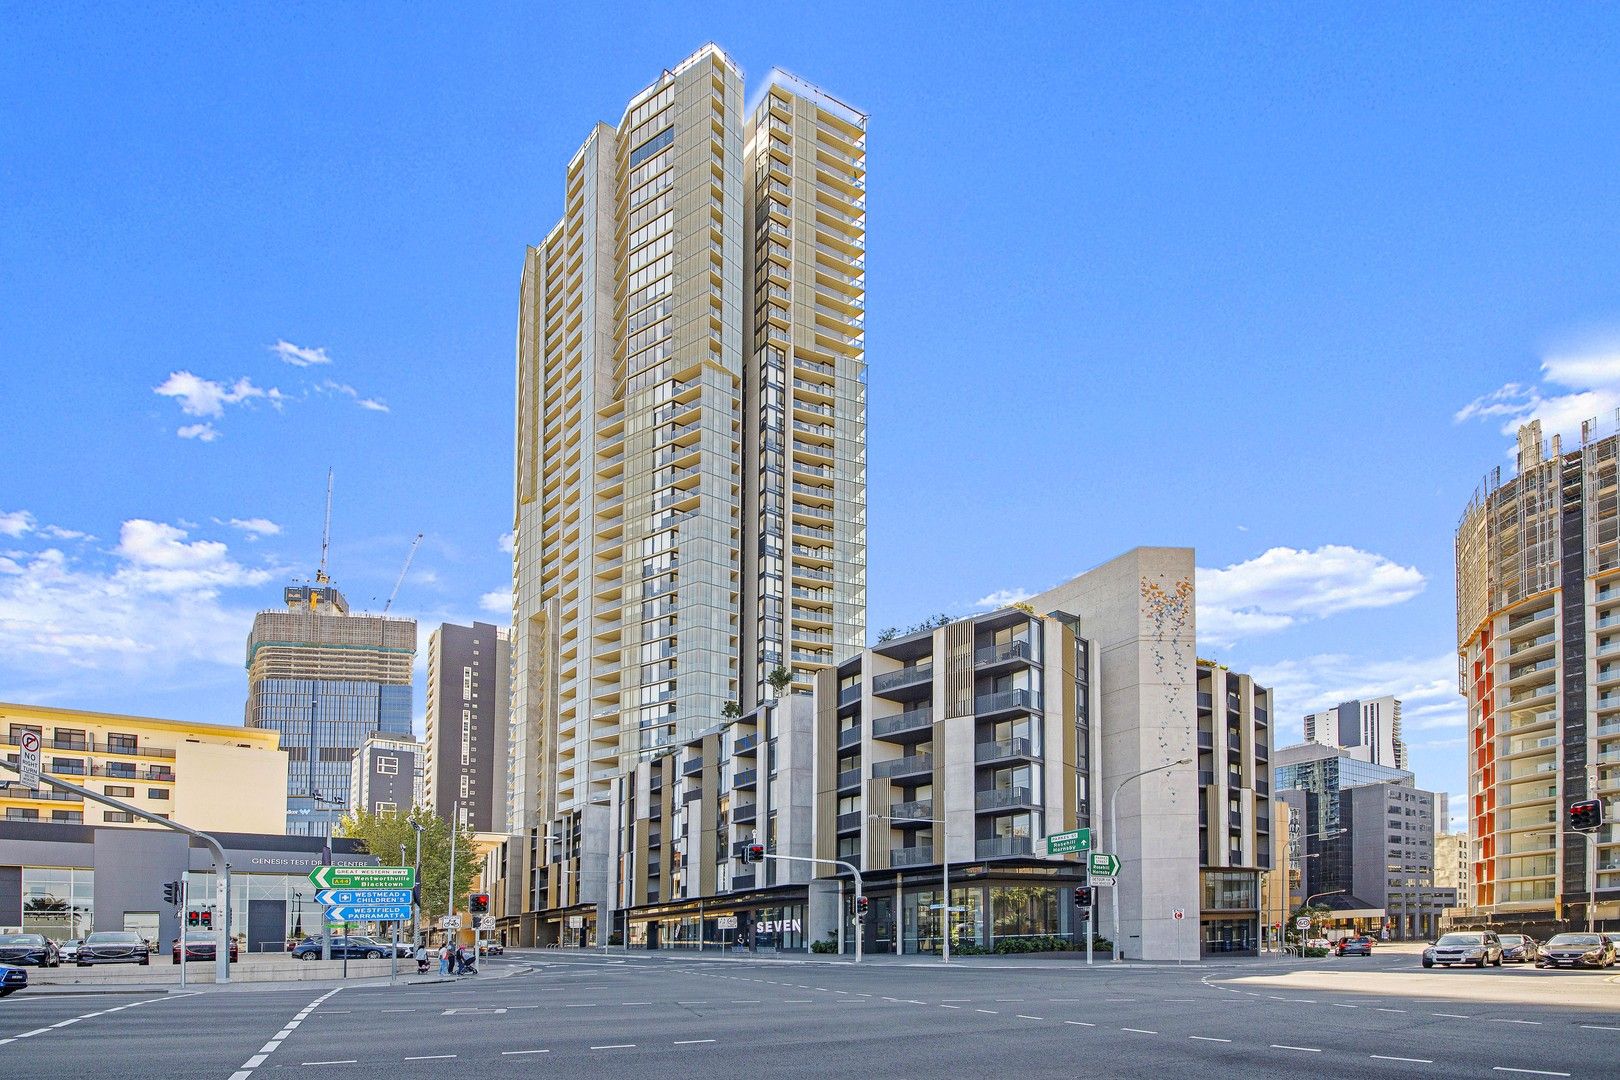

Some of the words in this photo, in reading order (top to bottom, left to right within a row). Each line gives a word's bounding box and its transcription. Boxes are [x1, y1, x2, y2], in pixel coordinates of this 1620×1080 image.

[24, 752, 36, 761] NO
[22, 759, 38, 768] RIGHT
[23, 766, 38, 774] TURN
[756, 918, 800, 933] SEVEN
